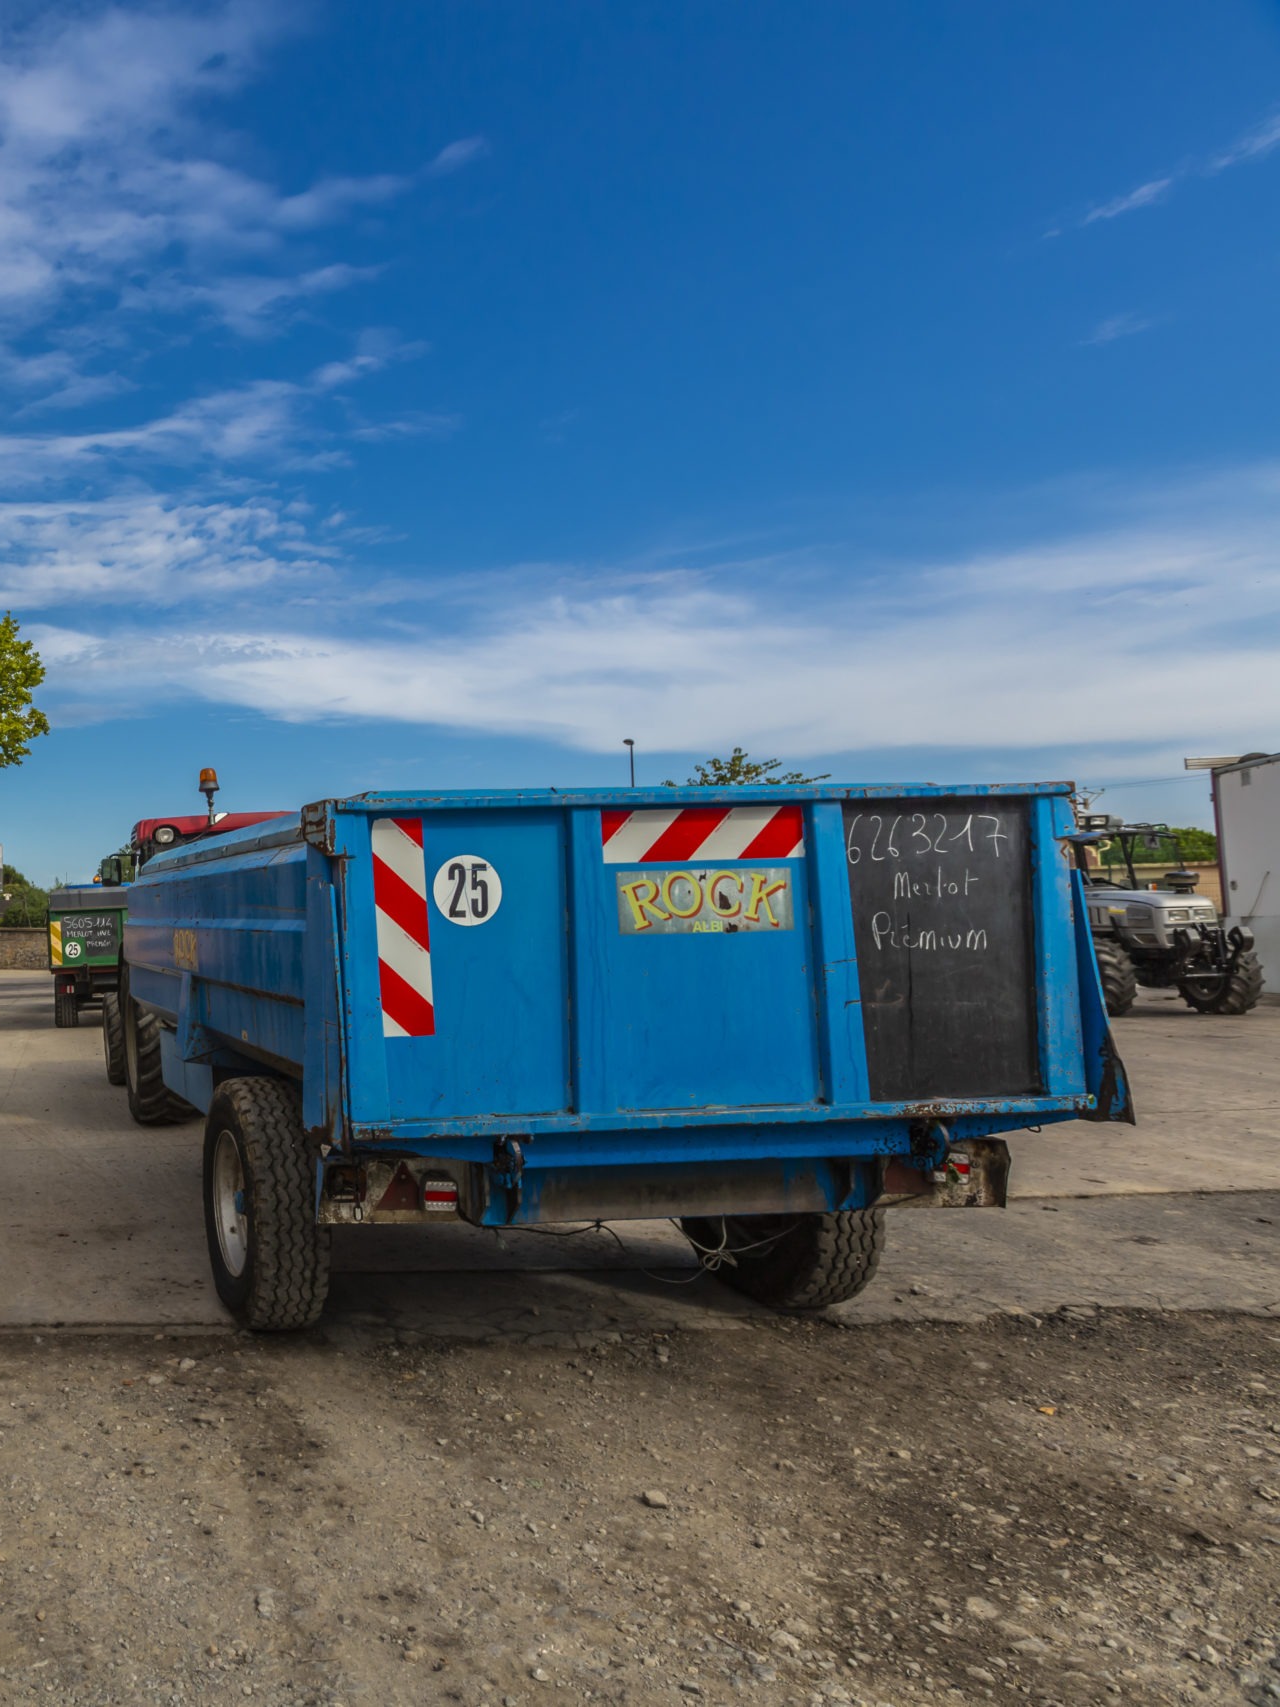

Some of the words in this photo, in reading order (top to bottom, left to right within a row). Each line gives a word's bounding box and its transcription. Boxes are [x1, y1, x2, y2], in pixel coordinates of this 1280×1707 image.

[847, 813, 1008, 864] 6263217
[447, 863, 489, 919] 25
[621, 870, 787, 931] ROCK
[894, 866, 979, 899] Merlot
[692, 920, 723, 933] ALBI
[68, 944, 79, 956] 25
